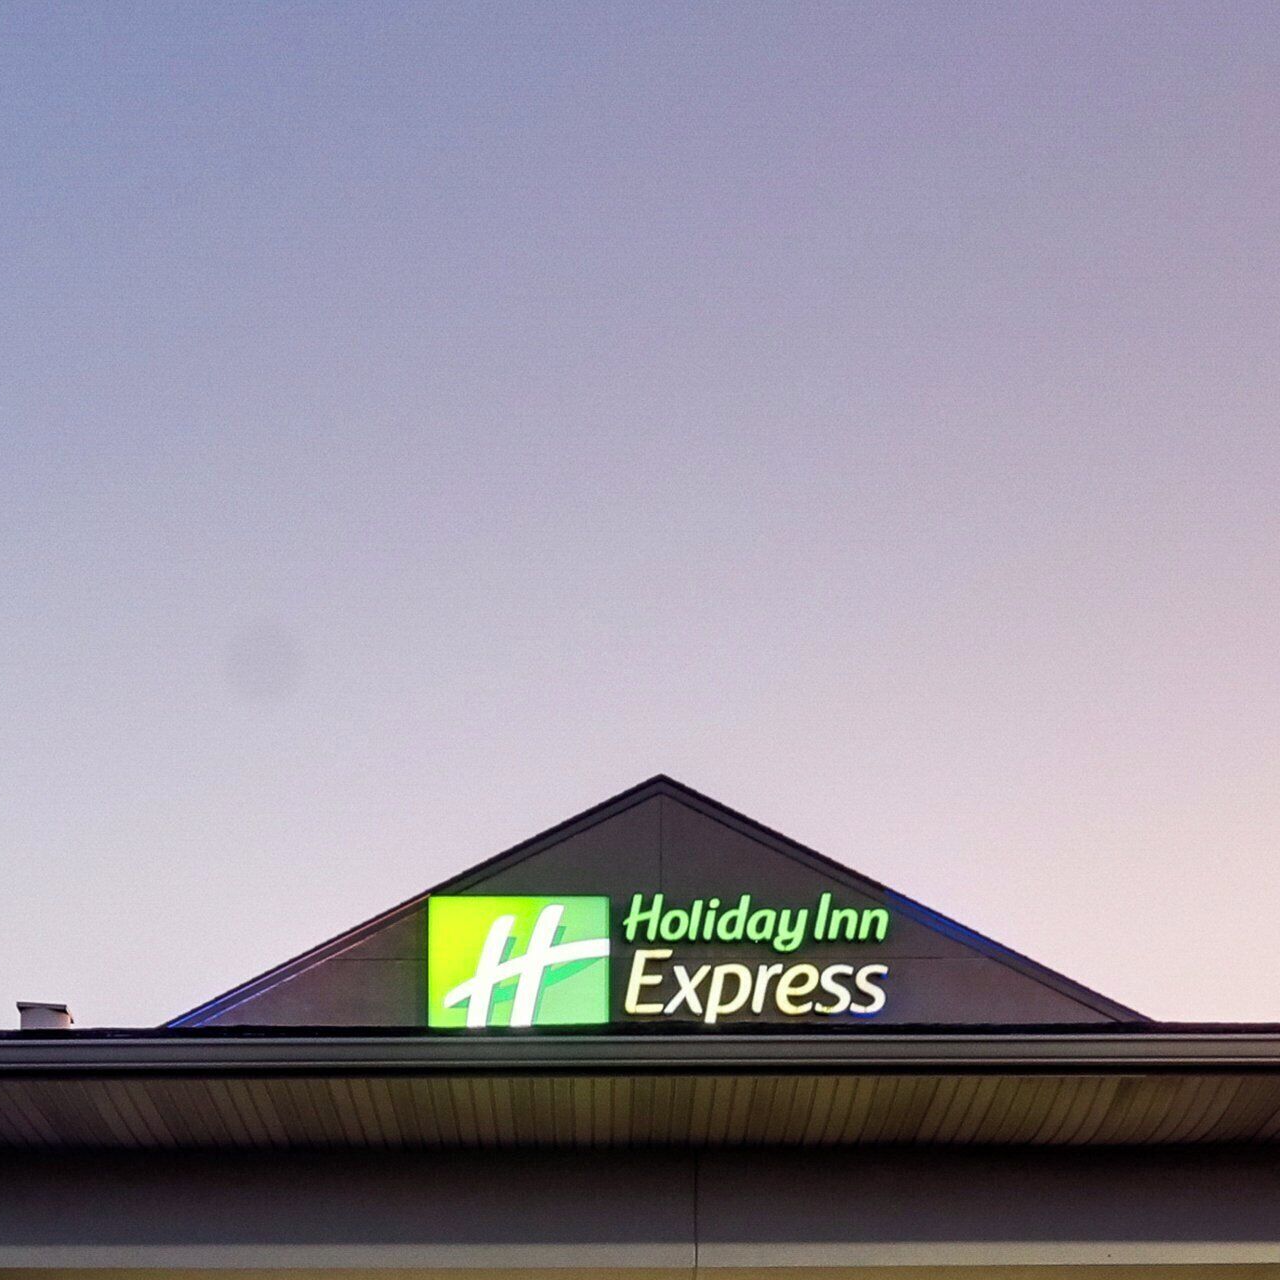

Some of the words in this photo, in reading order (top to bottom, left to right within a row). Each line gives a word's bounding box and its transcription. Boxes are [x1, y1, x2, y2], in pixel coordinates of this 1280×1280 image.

[622, 893, 808, 952] Holiday
[814, 892, 889, 941] Inn
[624, 948, 889, 1024] Express
